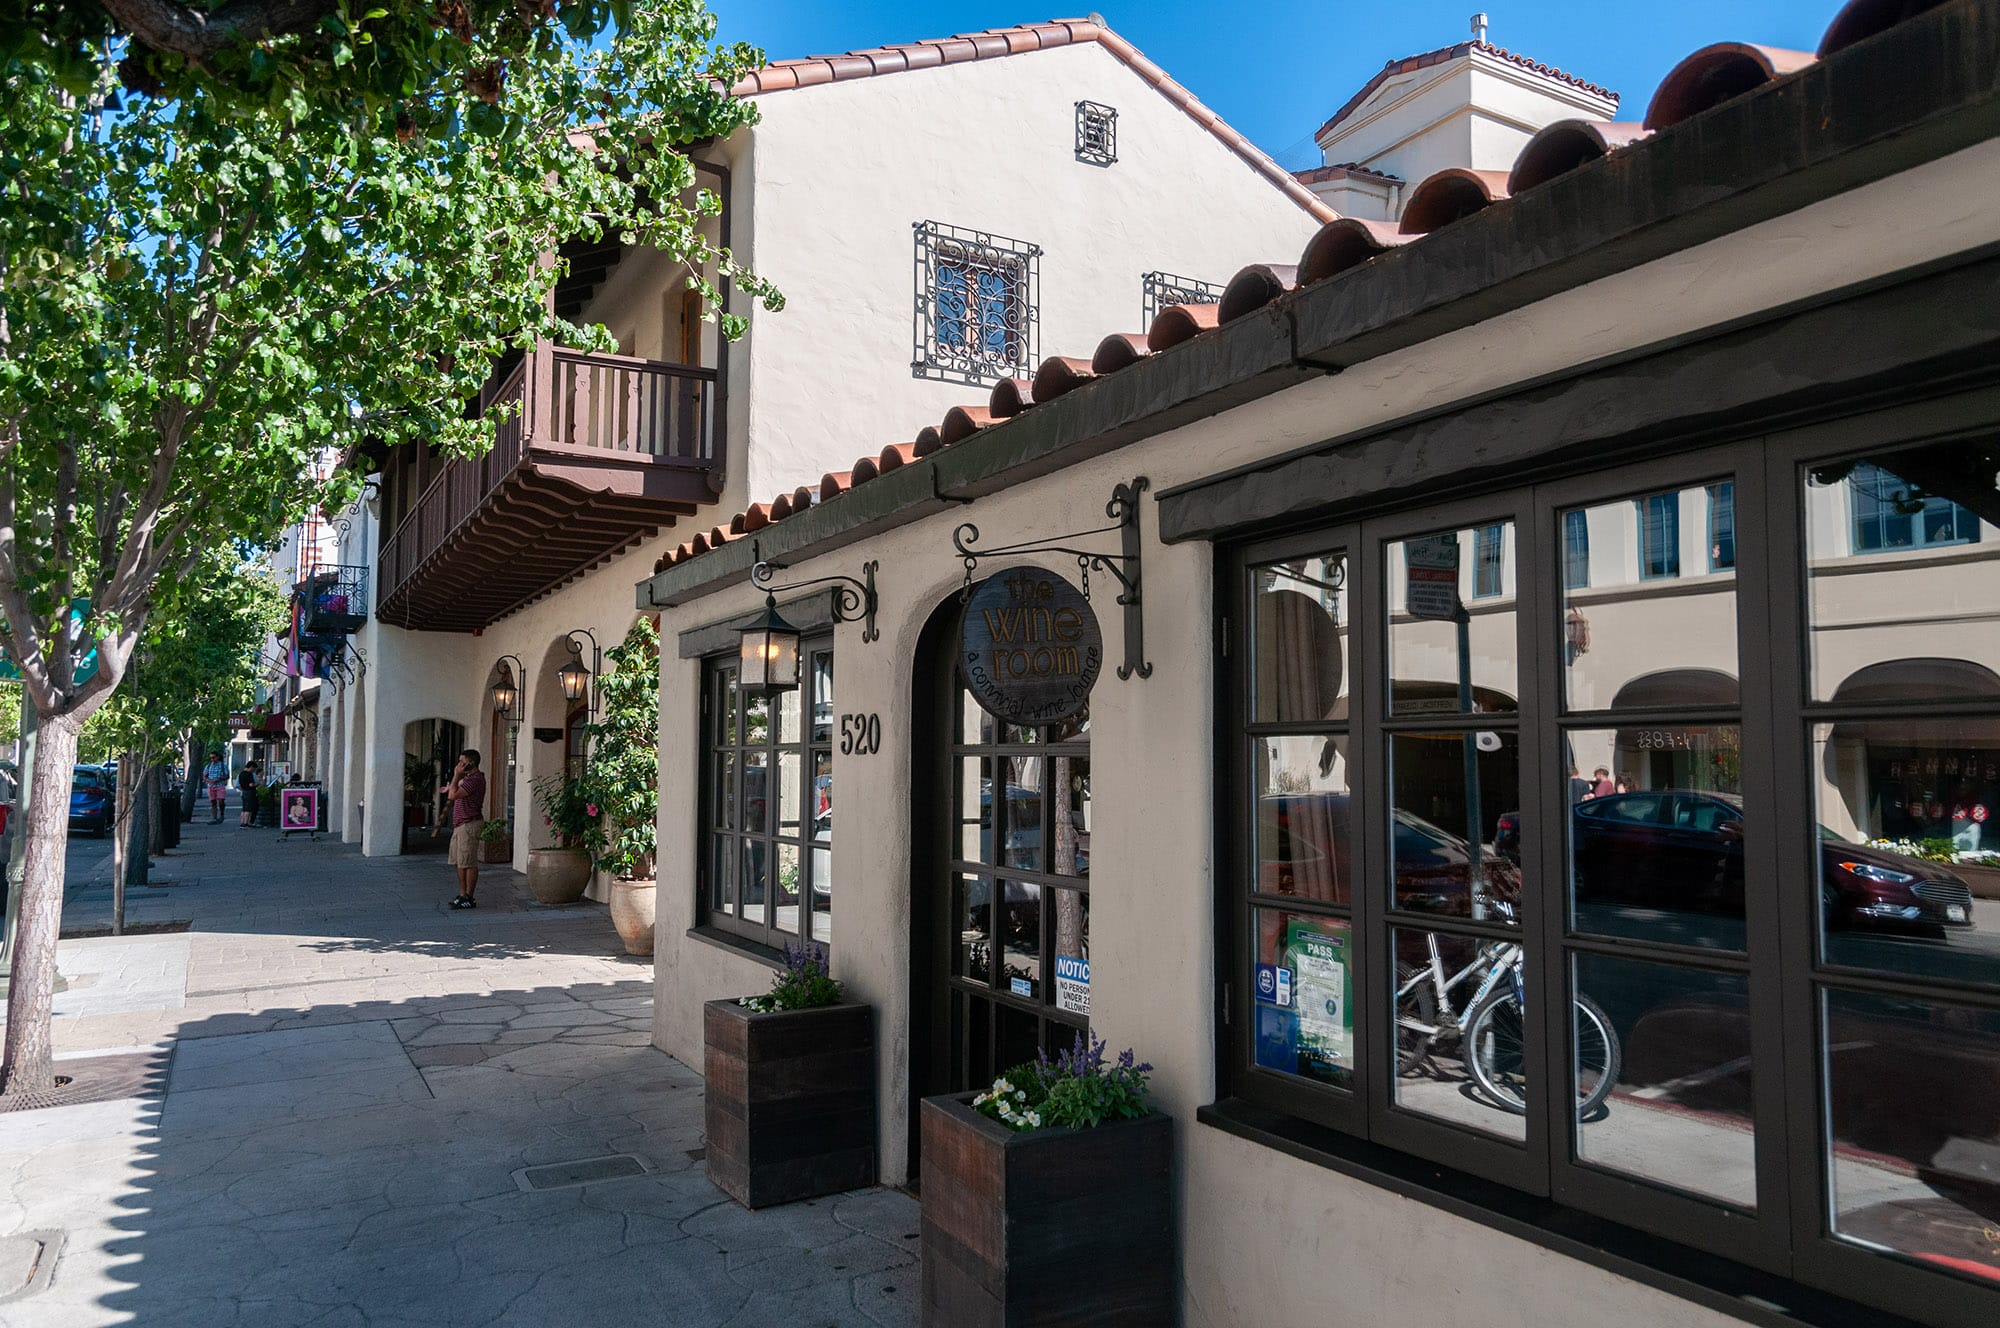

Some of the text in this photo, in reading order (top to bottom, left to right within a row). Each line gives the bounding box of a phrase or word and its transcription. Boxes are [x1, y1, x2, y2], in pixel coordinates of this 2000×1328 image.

[1004, 570, 1055, 601] the
[983, 602, 1084, 642] wine
[991, 646, 1080, 681] room
[967, 646, 1099, 719] a convivial wine lounge
[840, 713, 881, 756] 520
[1307, 943, 1333, 957] PASS
[1057, 958, 1090, 980] NOTIC
[1060, 981, 1068, 990] NO
[1064, 991, 1082, 1003] UNDER
